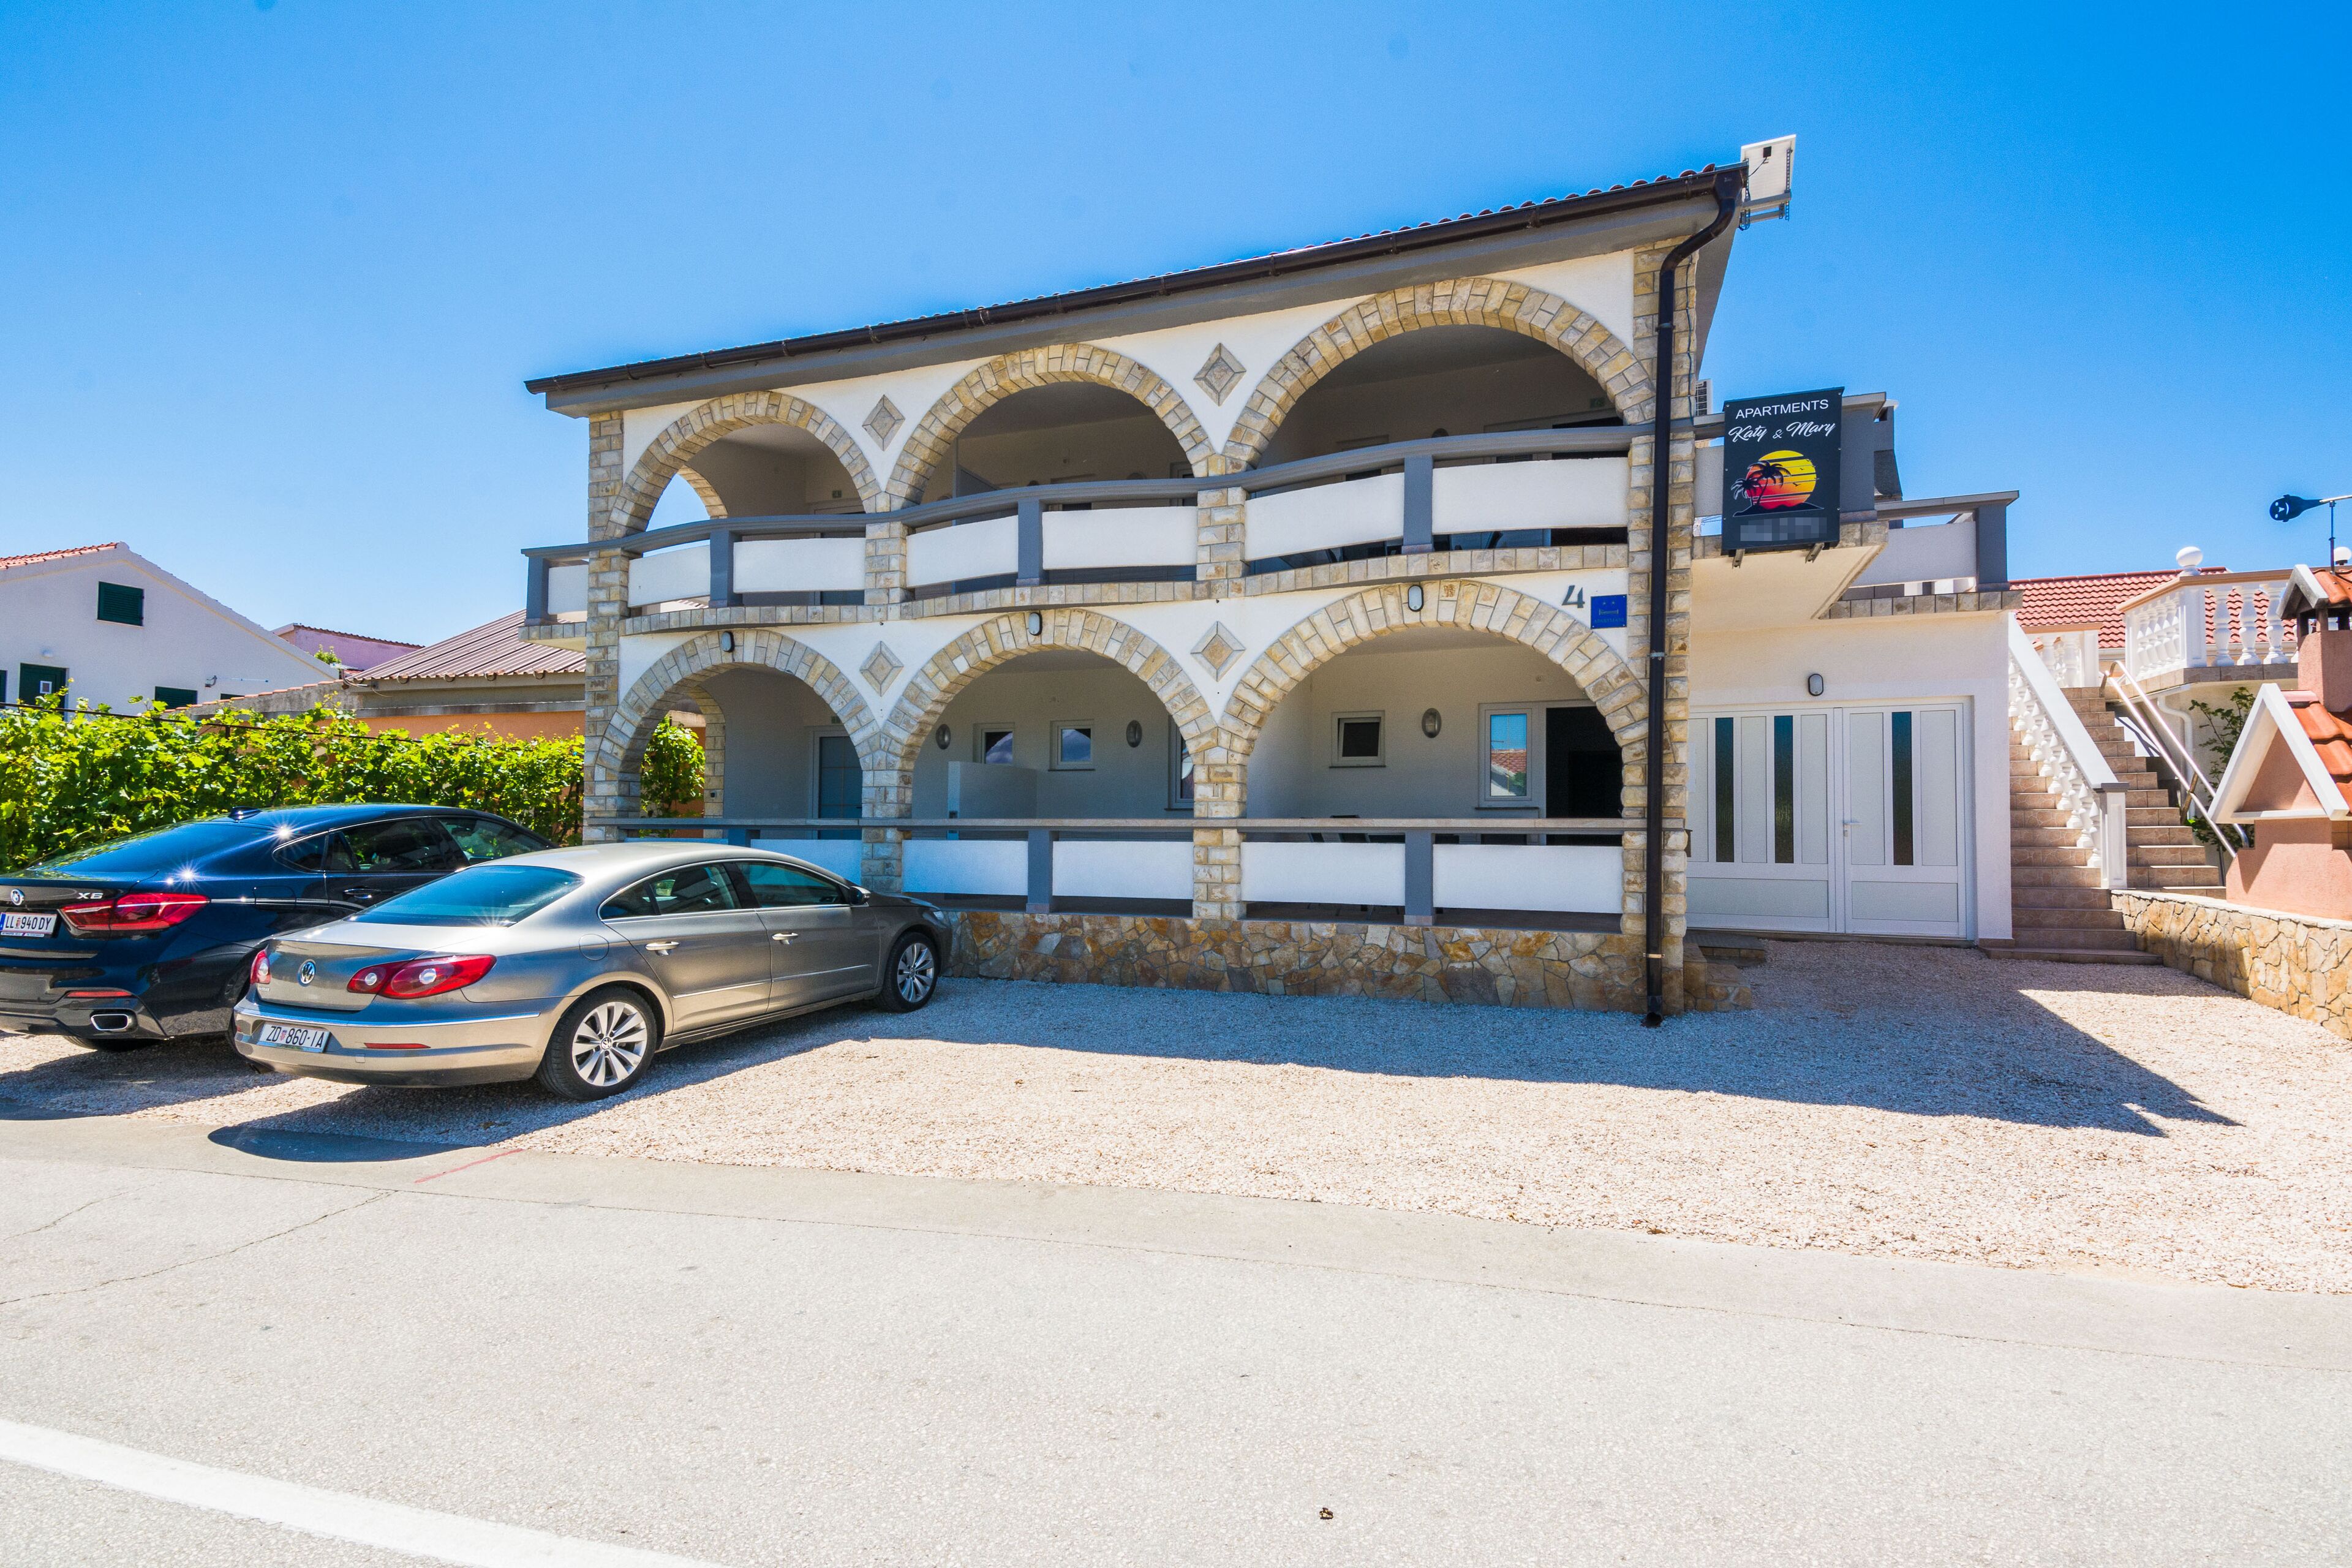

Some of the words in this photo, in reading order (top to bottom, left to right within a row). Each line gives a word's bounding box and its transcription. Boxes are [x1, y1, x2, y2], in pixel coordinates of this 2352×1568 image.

[1735, 399, 1829, 419] APARTMENTS
[1728, 425, 1767, 442] Katy
[1773, 429, 1783, 439] &
[1786, 421, 1836, 437] Mary
[1562, 585, 1585, 608] 4
[6, 916, 14, 929] LL
[266, 1026, 281, 1042] ZD
